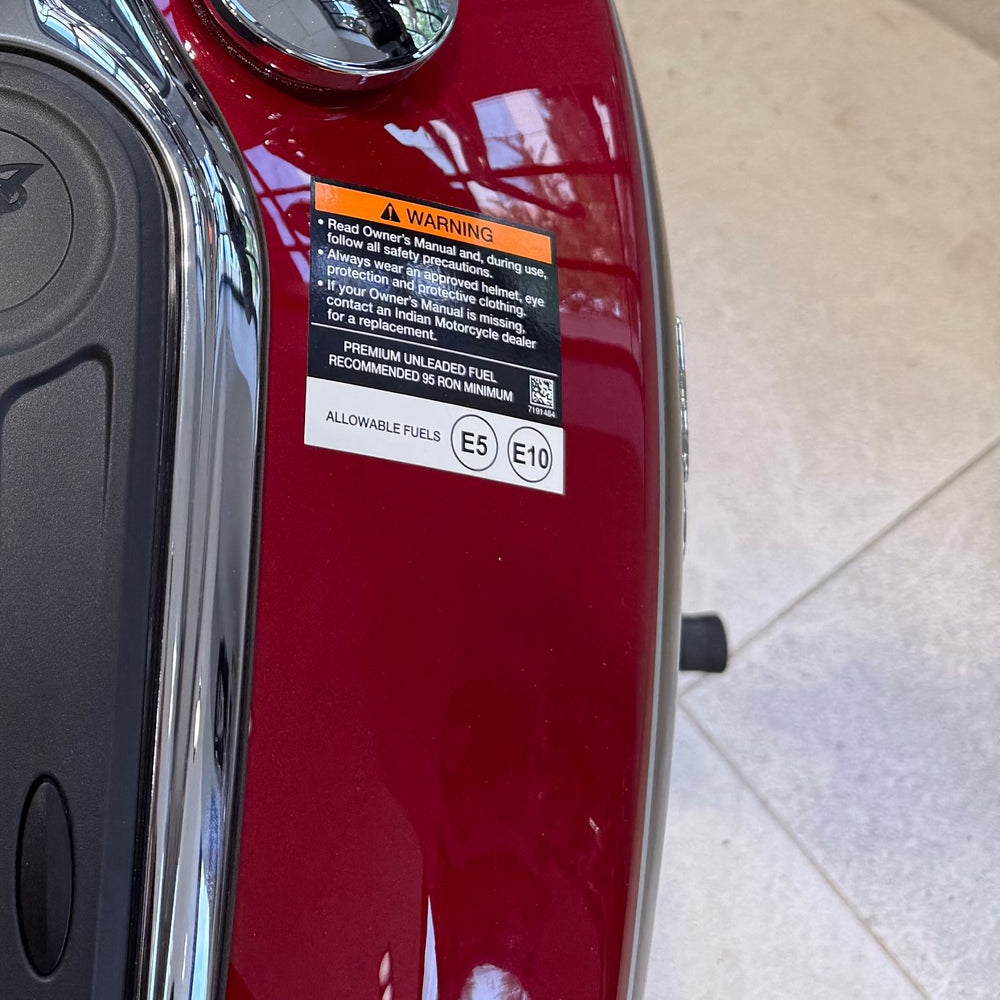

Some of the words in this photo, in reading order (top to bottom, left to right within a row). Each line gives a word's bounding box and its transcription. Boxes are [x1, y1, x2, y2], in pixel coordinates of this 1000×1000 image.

[406, 208, 493, 242] WARNING
[327, 218, 359, 235] Read
[362, 226, 411, 245] Owner's
[414, 237, 456, 255] Manual
[459, 247, 484, 264] and,
[487, 254, 522, 274] during
[524, 266, 548, 280] use,
[327, 233, 364, 248] follow
[367, 241, 381, 253] all
[384, 244, 420, 263] safety
[423, 254, 493, 278] precautions.
[327, 249, 372, 267] Always
[374, 259, 403, 275] wear
[406, 267, 420, 277] an
[424, 270, 478, 291] approved
[482, 281, 522, 302] helmet,
[526, 295, 544, 308] eye
[327, 264, 389, 286] protection
[392, 277, 414, 291] and
[418, 282, 475, 304] protective
[479, 295, 526, 317] clothing.
[326, 296, 374, 313] contact
[377, 305, 391, 316] an
[395, 307, 432, 325] Indian
[435, 316, 498, 341] Motorcycle
[502, 331, 536, 349] dealer
[327, 279, 336, 291] If
[339, 283, 366, 298] your
[369, 288, 418, 308] Owner's
[421, 299, 464, 318] Manual
[467, 308, 476, 320] is
[479, 311, 526, 334] missing,
[327, 309, 345, 321] for
[348, 315, 356, 325] a
[359, 316, 437, 341] replacement.
[329, 354, 420, 382] RECOMMENDED
[423, 373, 434, 385] 95
[437, 377, 461, 391] RON
[464, 382, 513, 402] MINIMUM
[344, 341, 400, 362] PREMIUM
[404, 354, 466, 375] UNLEADED
[469, 366, 497, 383] FUEL
[326, 411, 400, 434] ALLOWABLE
[404, 426, 441, 442] FUELS
[461, 430, 488, 456] E5
[513, 442, 549, 469] E10
